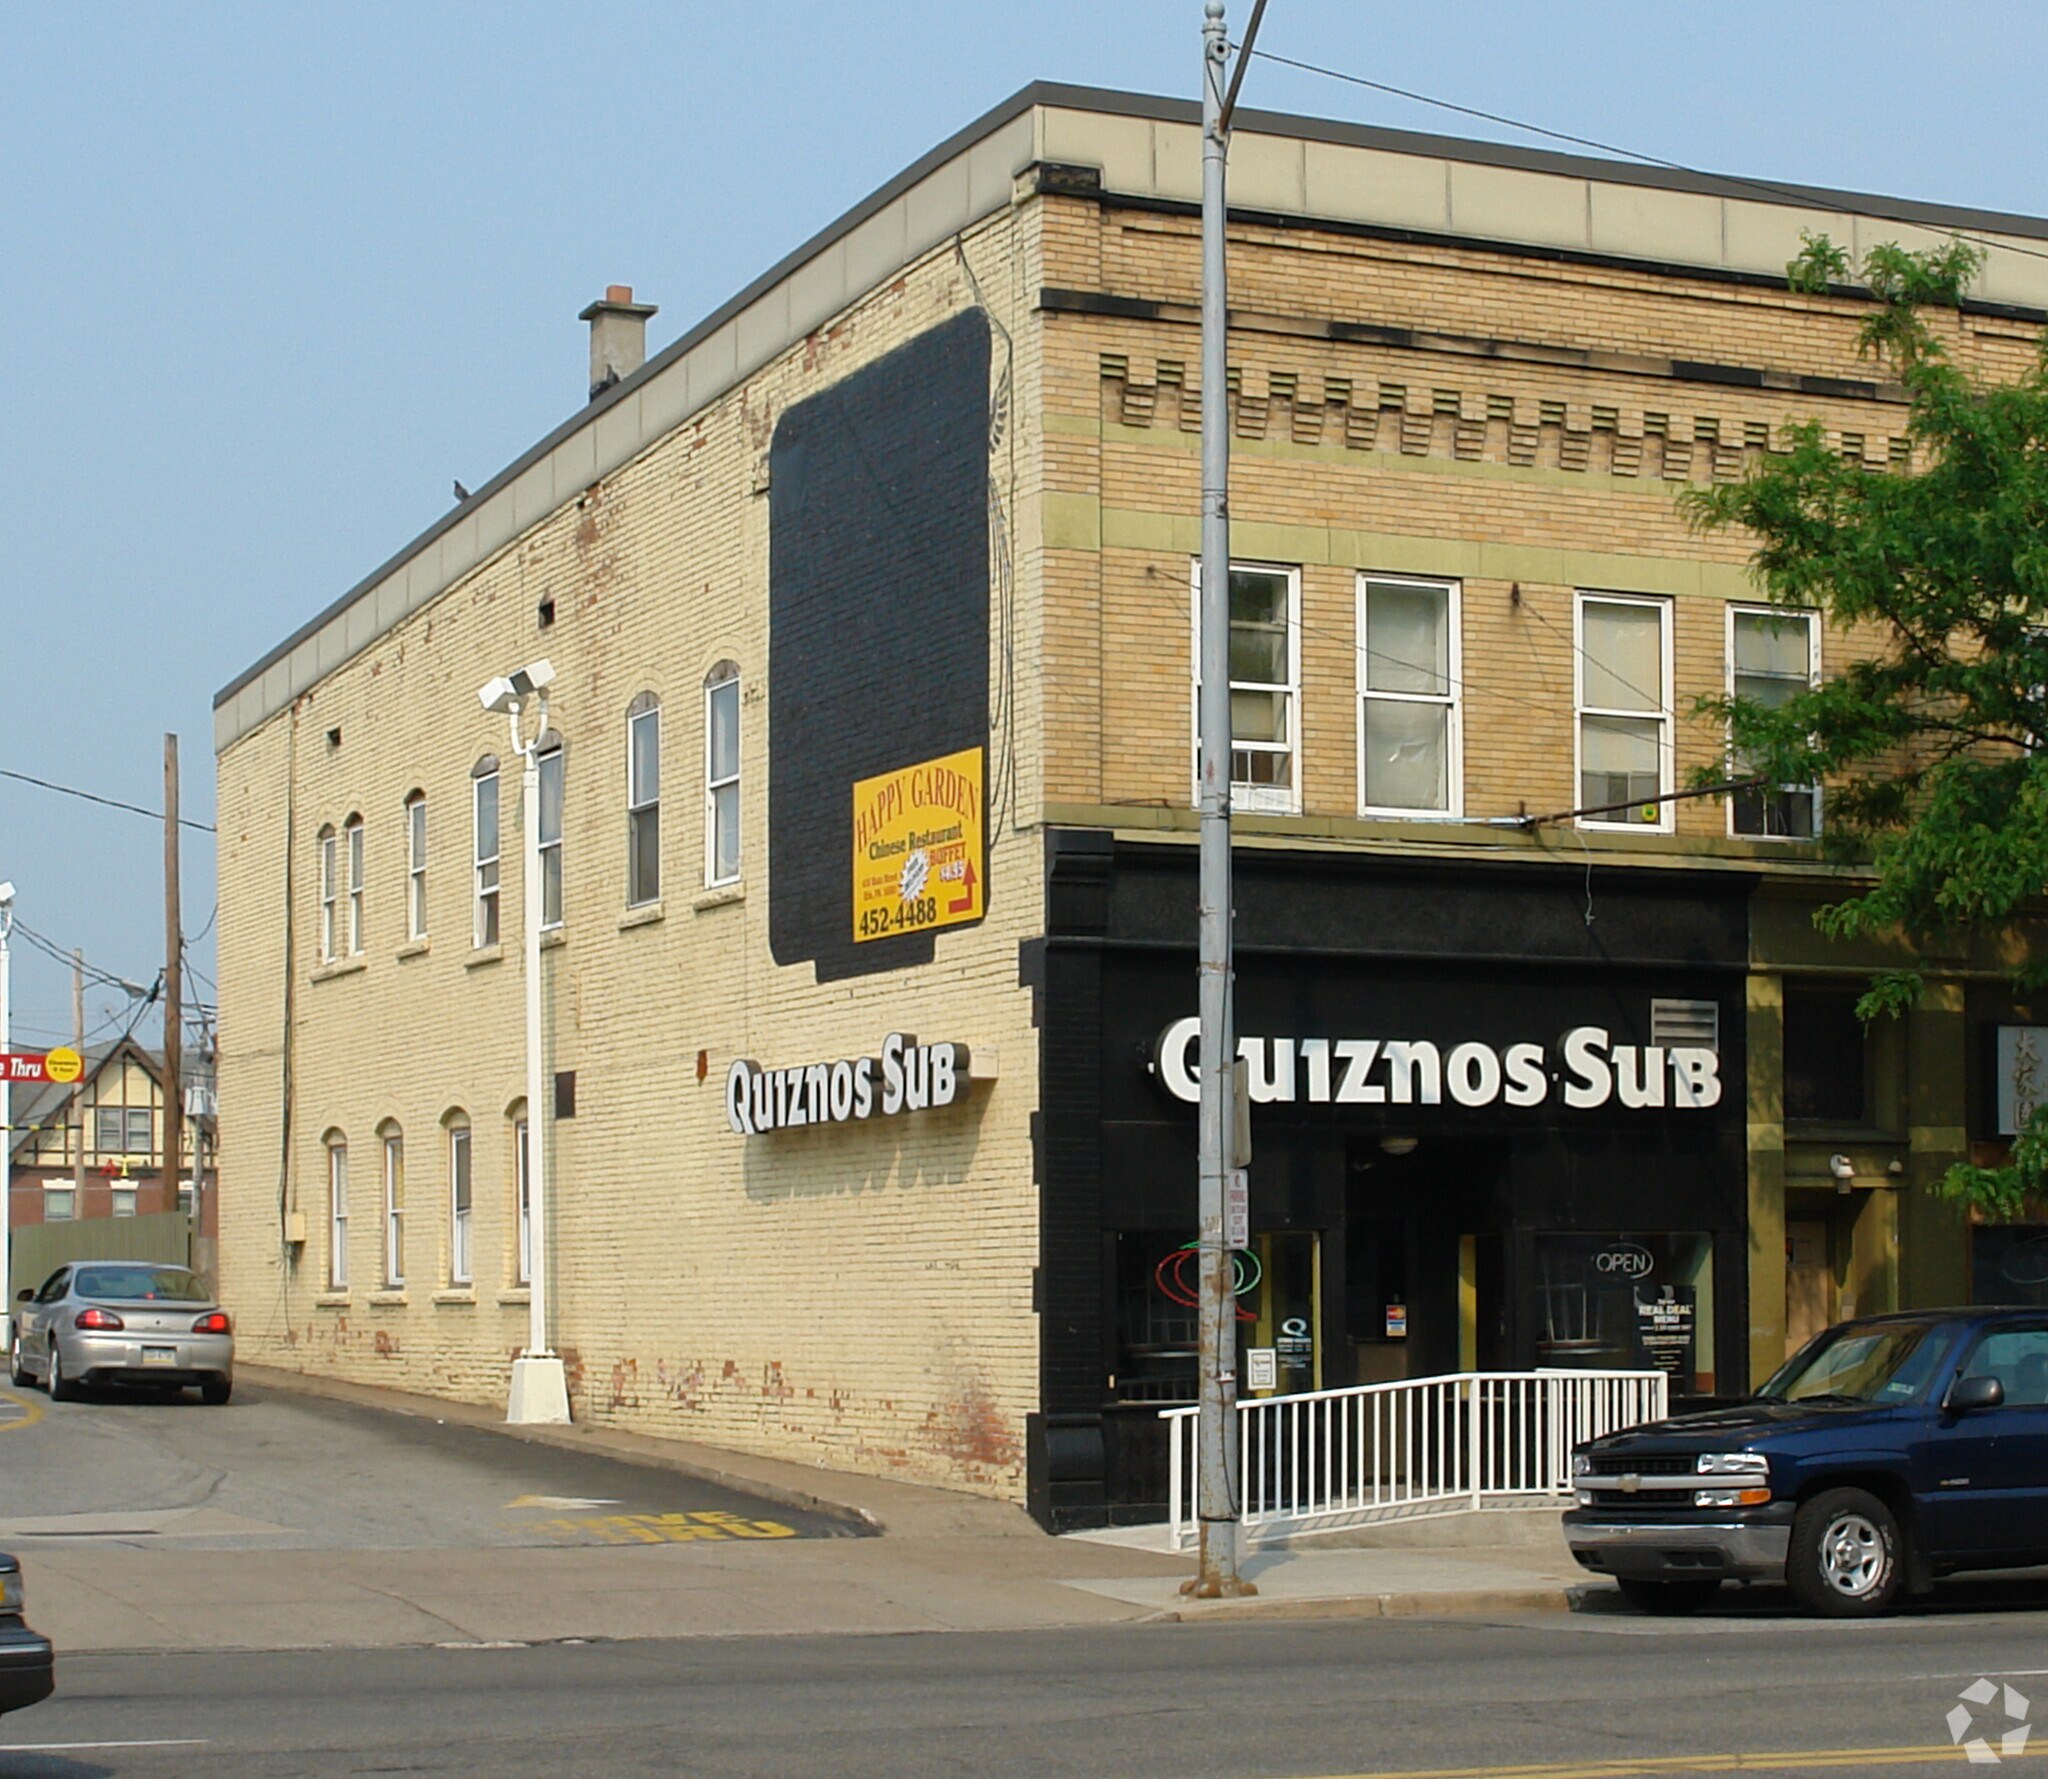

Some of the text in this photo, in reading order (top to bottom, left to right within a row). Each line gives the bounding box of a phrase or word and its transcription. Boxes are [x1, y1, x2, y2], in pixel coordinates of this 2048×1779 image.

[859, 768, 978, 852] HAPPY GARDEN
[870, 821, 963, 860] Chinese Restaurant
[860, 897, 936, 935] 452-4488
[10, 1057, 41, 1077] Thru
[1597, 1253, 1645, 1272] OPEN
